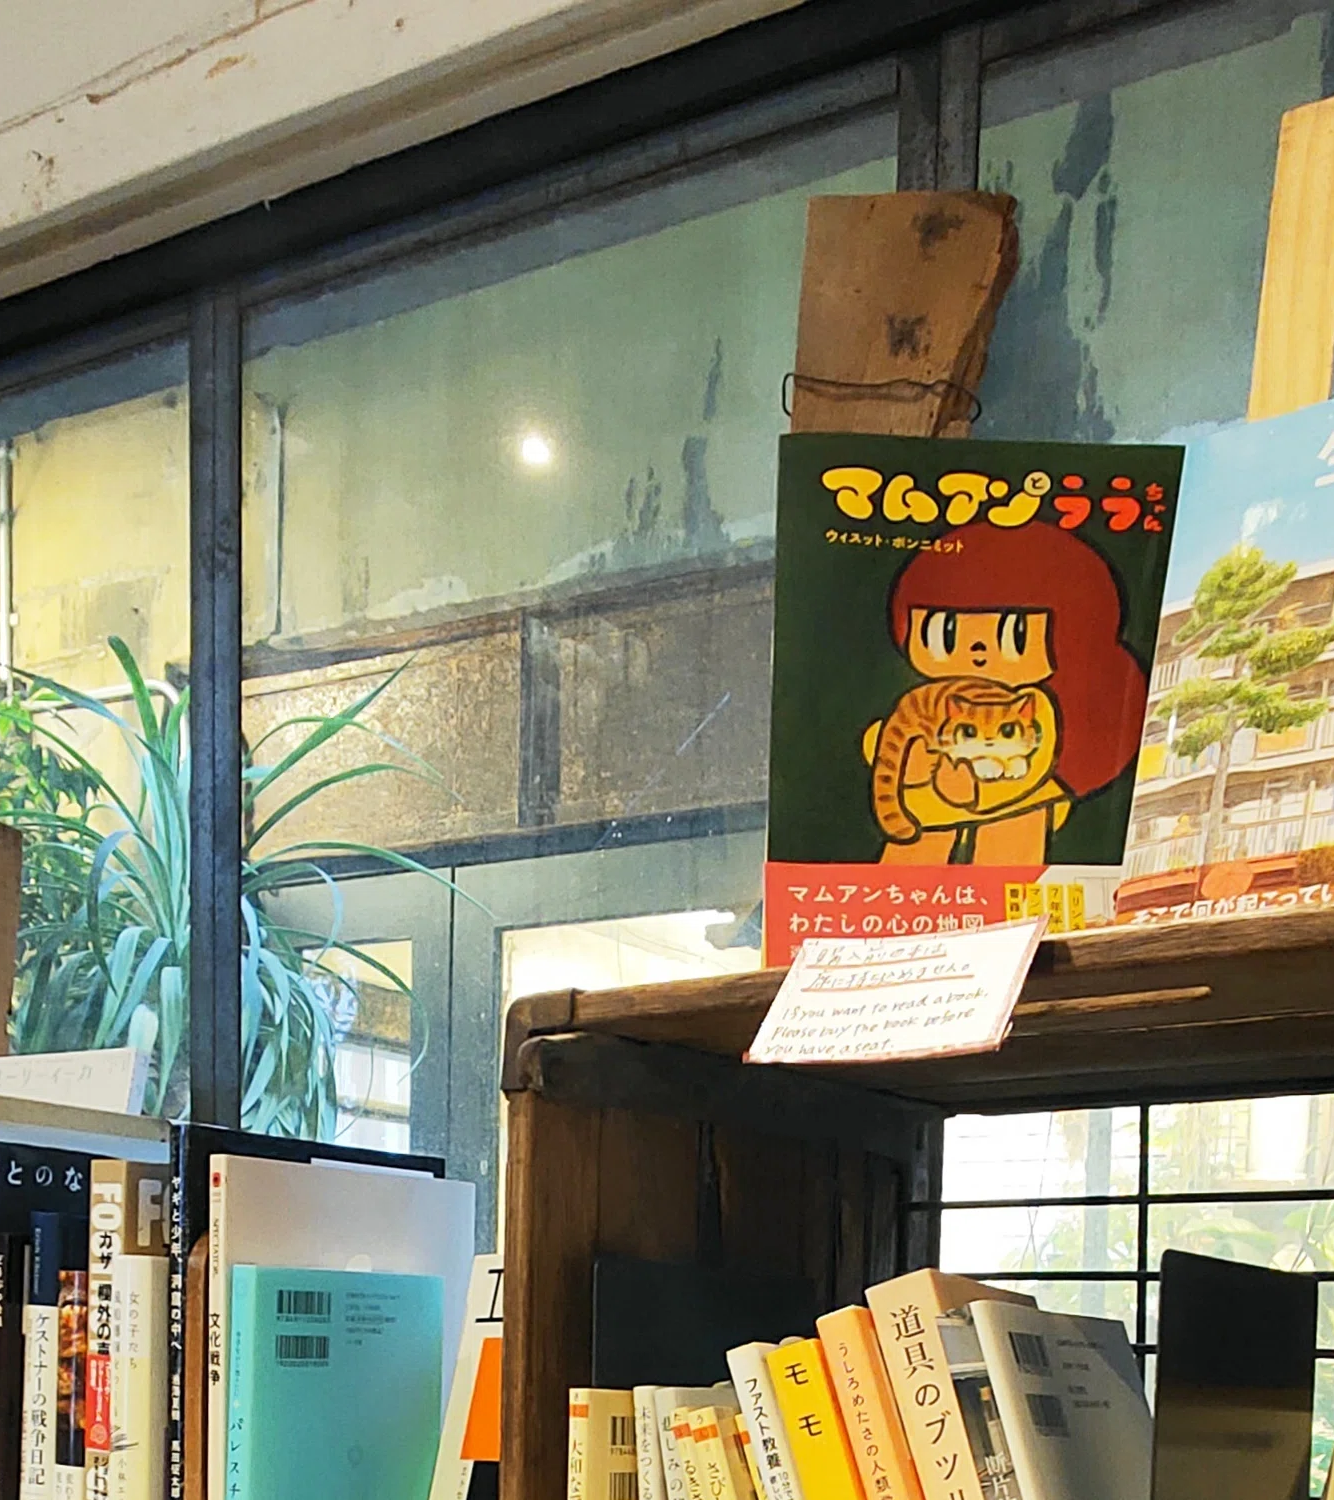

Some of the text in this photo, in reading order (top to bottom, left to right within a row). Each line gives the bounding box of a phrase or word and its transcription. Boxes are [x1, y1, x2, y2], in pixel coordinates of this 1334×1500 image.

[824, 529, 966, 556] ウィスット・ポンニミット
[787, 885, 990, 906] マムアンちゃんは、
[789, 914, 985, 935] わたしの心の地図
[832, 1003, 866, 1018] want
[871, 1002, 888, 1015] to
[891, 993, 928, 1013] read
[771, 1007, 976, 1041] Please buy the book before
[798, 1042, 835, 1058] have
[209, 1313, 221, 1387] 文化戦争
[28, 1313, 50, 1486] ケストナーの戦争日記
[784, 1361, 823, 1438] モモ
[744, 1377, 783, 1470] ファスト教養
